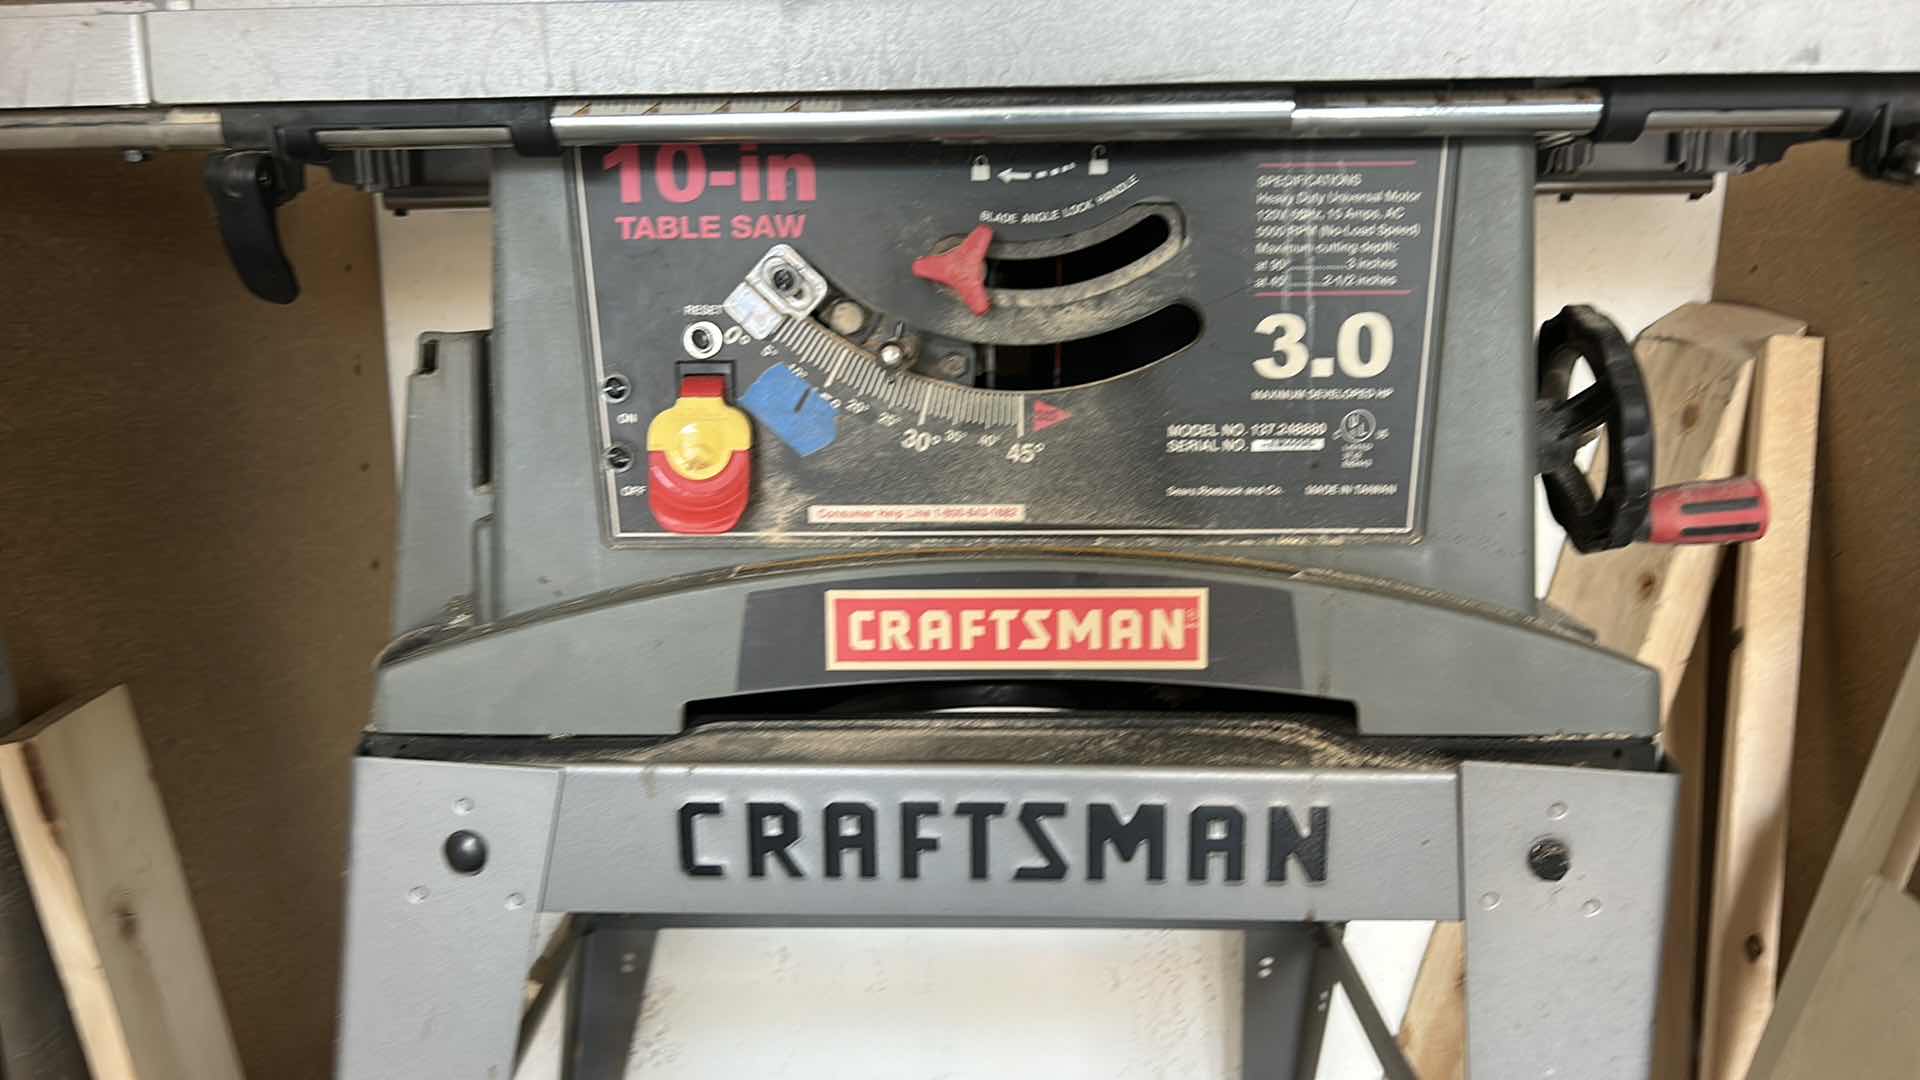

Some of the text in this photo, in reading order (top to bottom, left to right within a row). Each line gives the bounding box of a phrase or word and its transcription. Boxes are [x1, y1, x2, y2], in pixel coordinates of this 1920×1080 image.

[602, 143, 816, 204] 10-in
[1256, 173, 1362, 187] SPECIFICATIONS
[979, 173, 1140, 224] BLADE ANGLE LOCK HANDLE
[1256, 190, 1423, 206] Heavy Duty Universal Motor
[1384, 206, 1406, 219] AC
[614, 213, 807, 240] TABLE SAW
[1287, 225, 1318, 237] RPM
[1255, 243, 1314, 255] Maximum
[1316, 242, 1360, 256] cutting
[1254, 260, 1268, 272] at
[1358, 258, 1398, 270] inches
[1357, 274, 1397, 287] inches
[683, 304, 724, 316] RESET
[1252, 311, 1394, 380] 3.0
[1251, 387, 1394, 400] MAXIMUM DEVELOPED HP
[616, 413, 638, 424] ON
[1167, 423, 1220, 437] MODEL
[1220, 422, 1248, 436] NO.
[901, 428, 942, 452] 30°
[1166, 439, 1220, 453] SERIAL
[1221, 439, 1249, 452] NO.
[1006, 442, 1045, 464] 45°
[620, 486, 646, 497] OFF
[1244, 485, 1265, 496] and
[1305, 483, 1398, 496] MADE IN TAIWAN
[847, 607, 1186, 652] CRAFTSMAN
[677, 801, 1331, 882] CRAFTSMAN
